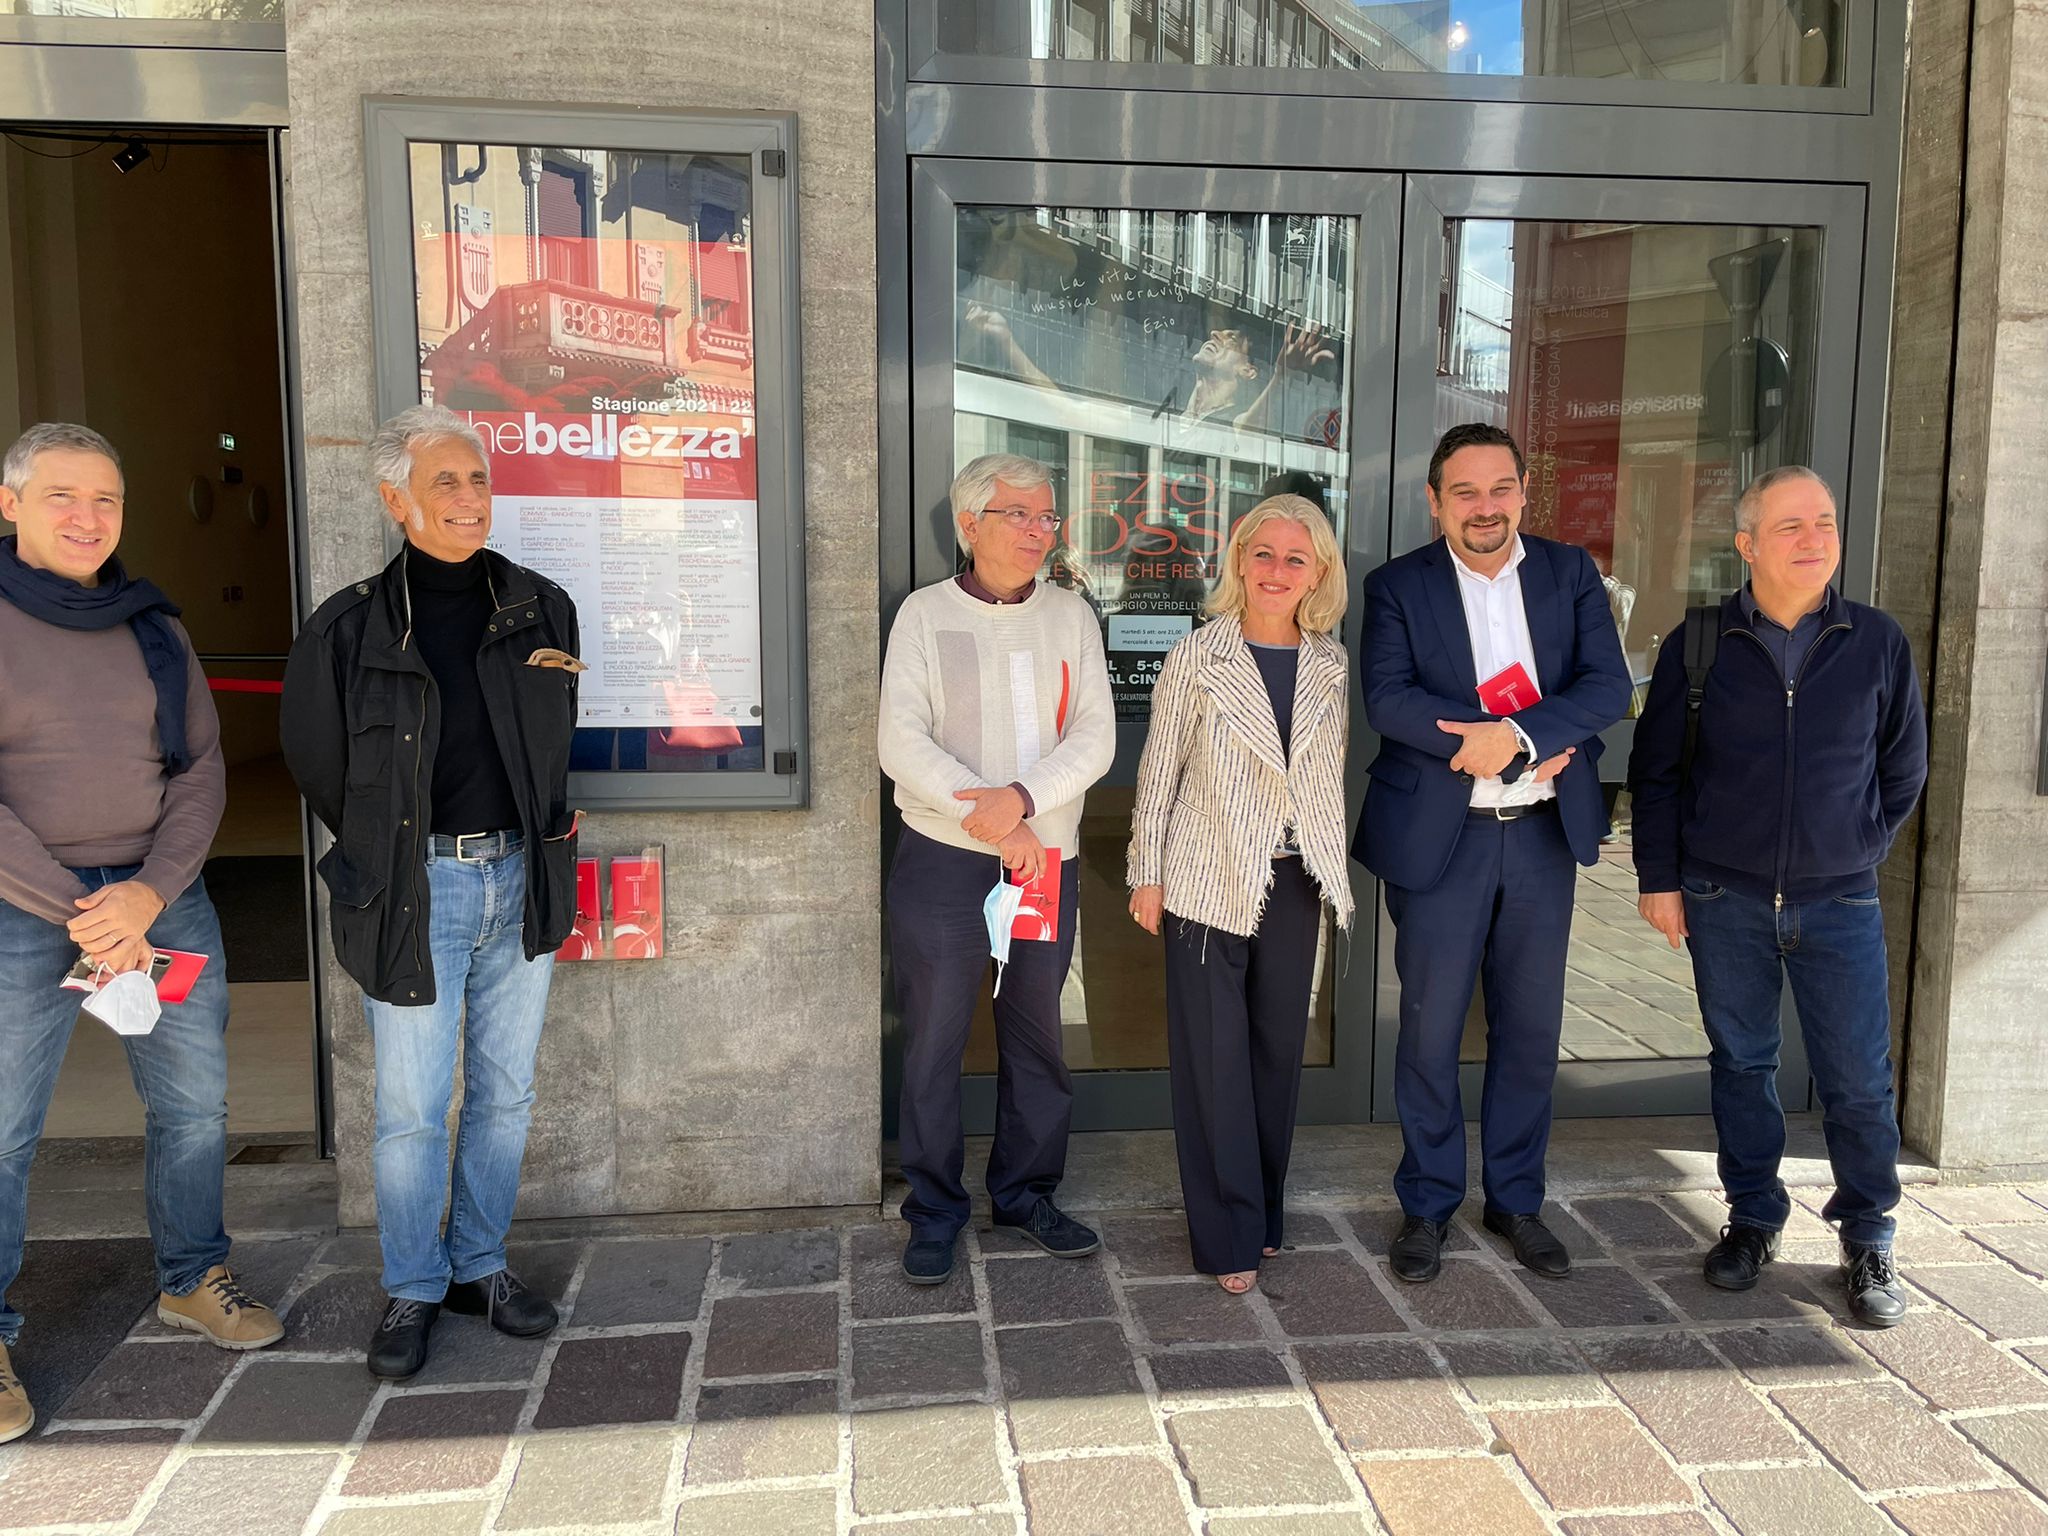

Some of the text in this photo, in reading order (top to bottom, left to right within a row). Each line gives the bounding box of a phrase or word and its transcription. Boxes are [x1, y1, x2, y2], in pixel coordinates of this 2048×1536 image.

[1060, 275, 1085, 292] La
[1098, 268, 1136, 285] vita
[1552, 284, 1588, 299] 2016
[1031, 297, 1097, 313] musica
[1563, 308, 1609, 321] Musica
[1144, 317, 1175, 335] Ezio
[1545, 327, 1562, 426] FARAGGIANA
[591, 398, 669, 414] Stagione
[676, 400, 715, 413] 2021
[730, 401, 752, 414] 22
[1090, 472, 1215, 506] EZIO
[1127, 563, 1167, 578] CHE
[1102, 601, 1200, 611] GIORGIO VERDELLI
